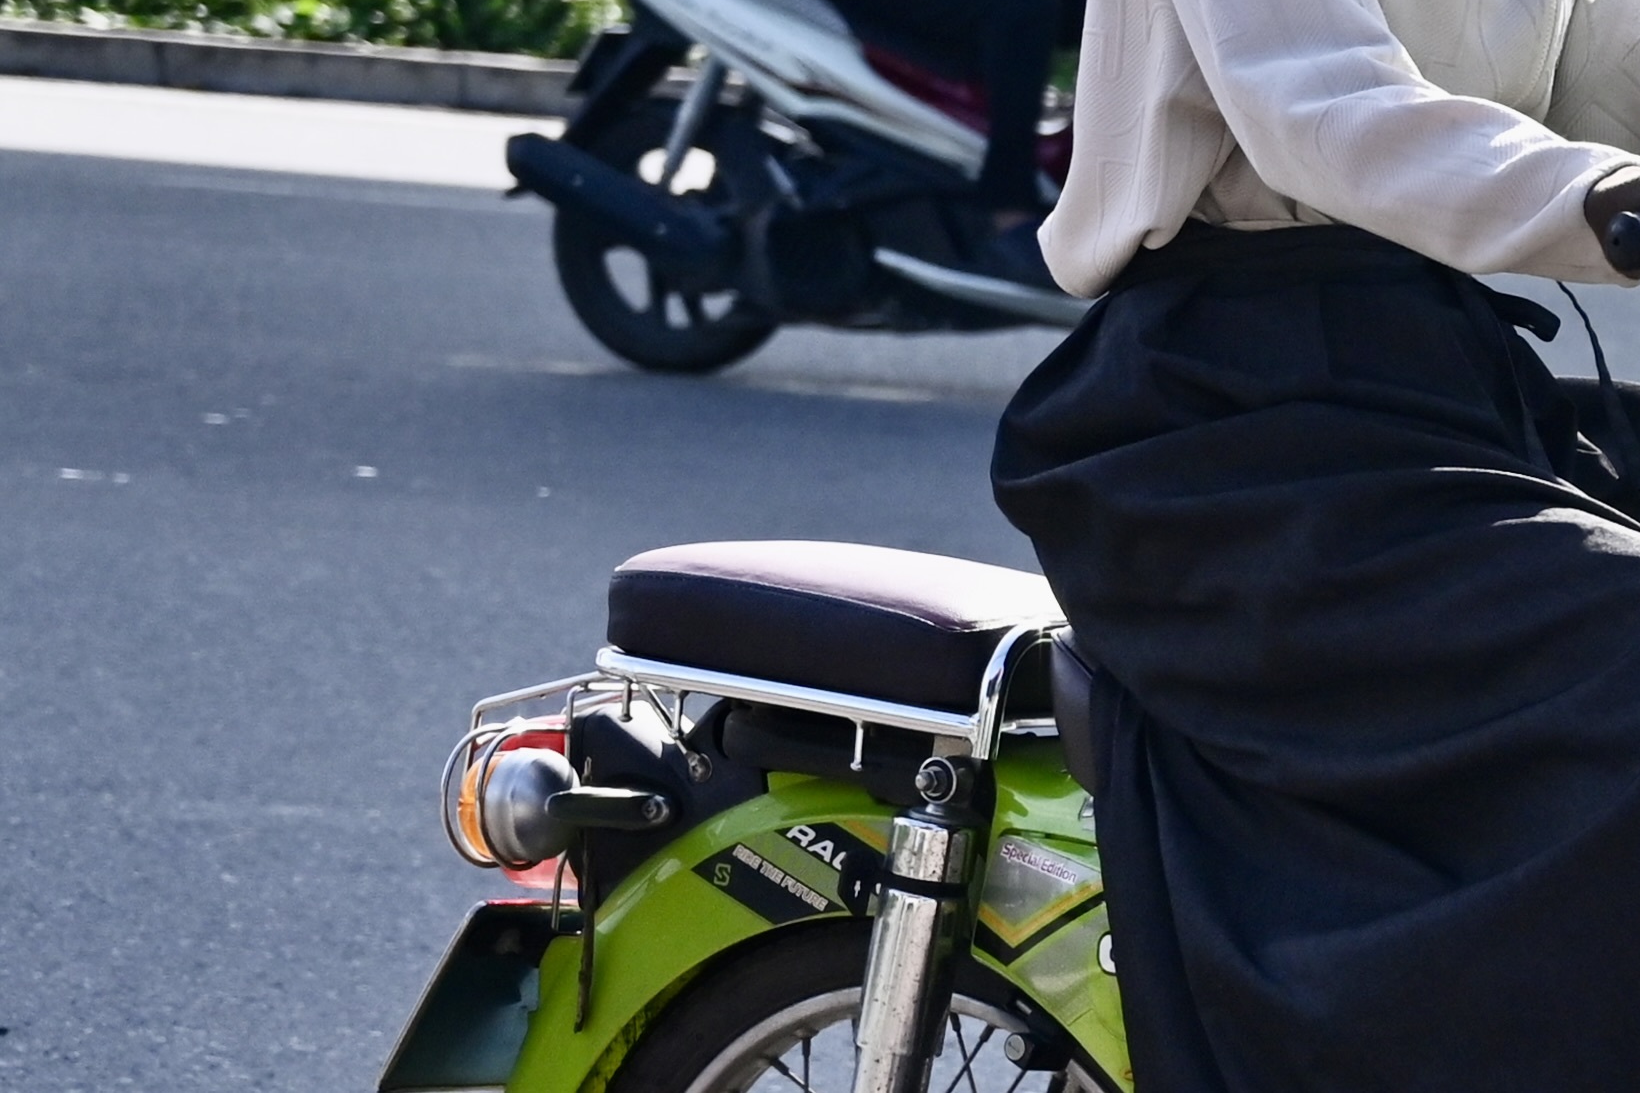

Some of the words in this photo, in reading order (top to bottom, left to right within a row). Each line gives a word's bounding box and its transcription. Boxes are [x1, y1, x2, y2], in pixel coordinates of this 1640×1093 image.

[732, 844, 762, 870] RIDE
[760, 860, 785, 885] THE
[780, 875, 829, 912] FUTURE
[1001, 842, 1040, 868] Special
[1040, 858, 1077, 884] Edition
